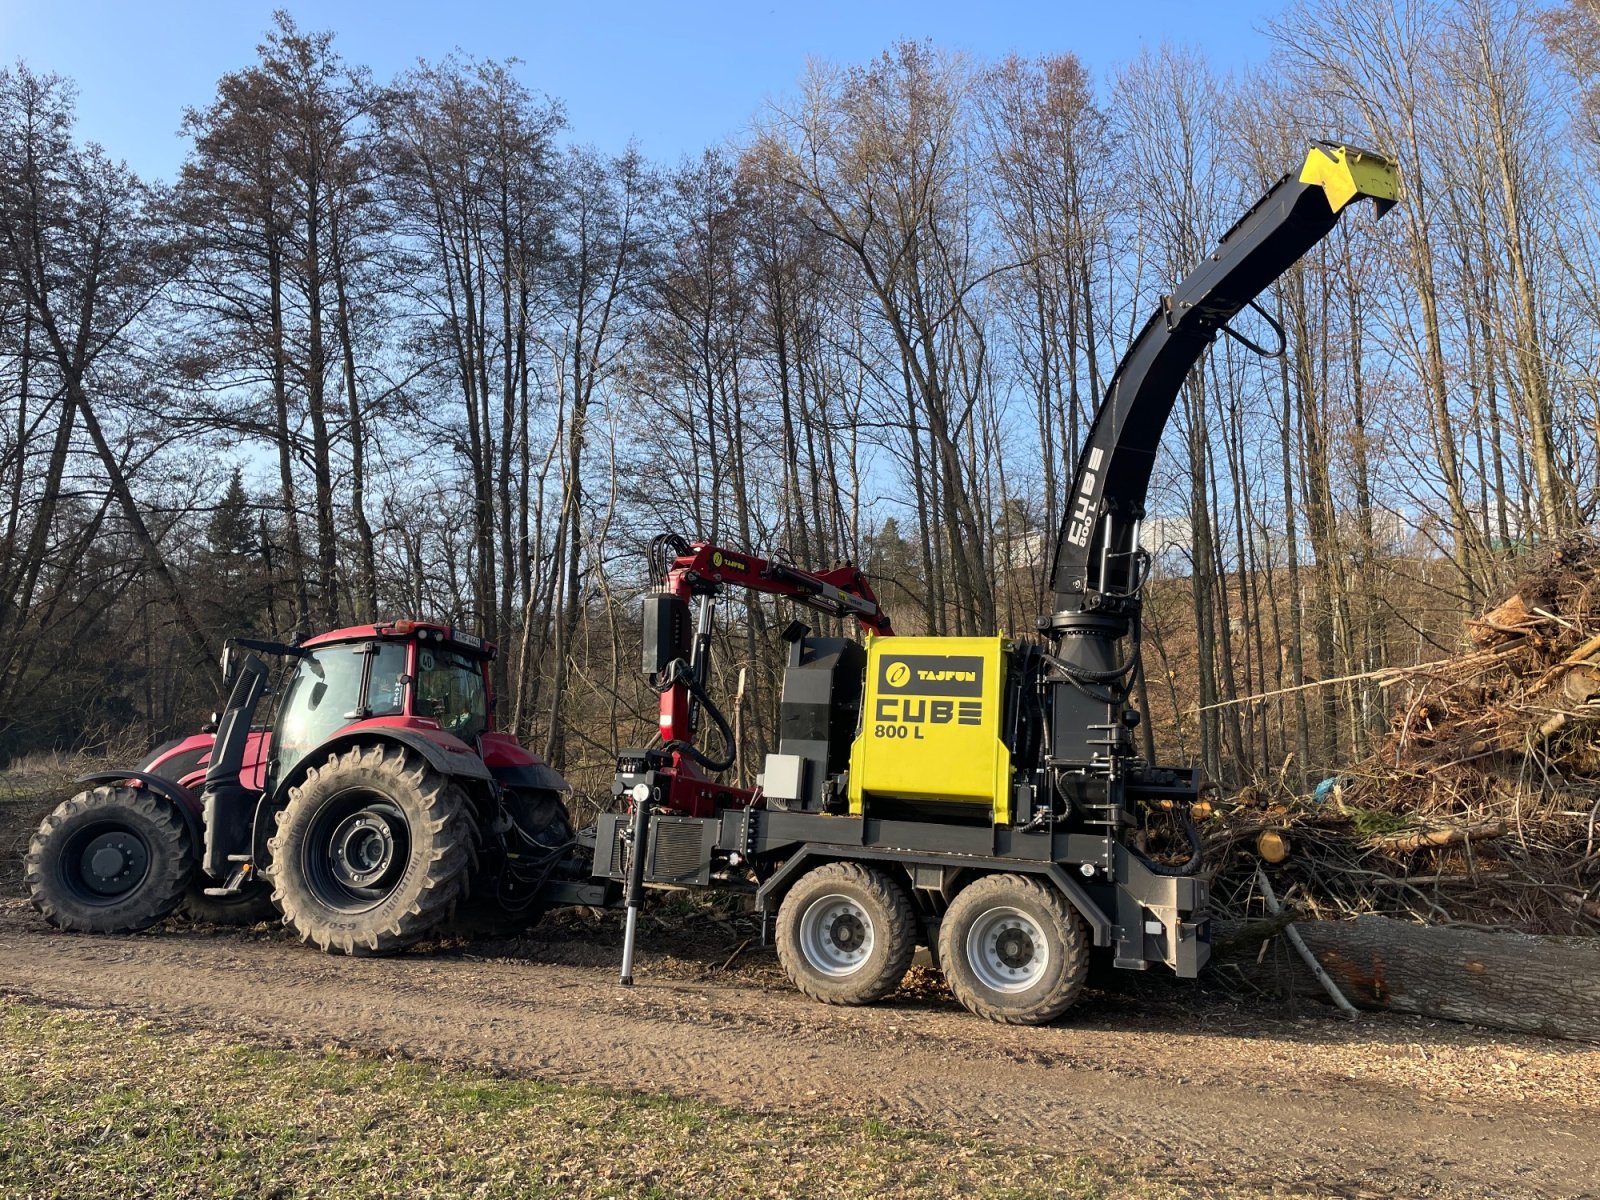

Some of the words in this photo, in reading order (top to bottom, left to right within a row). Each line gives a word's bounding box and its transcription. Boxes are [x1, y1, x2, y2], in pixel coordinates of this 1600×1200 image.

[1067, 446, 1104, 545] CUBE
[1079, 516, 1092, 547] 800
[1088, 502, 1097, 512] L
[917, 670, 976, 682] TAJFUN
[392, 682, 401, 706] MAYER
[876, 698, 983, 725] CUBE
[874, 724, 908, 739] 800
[914, 726, 924, 739] L
